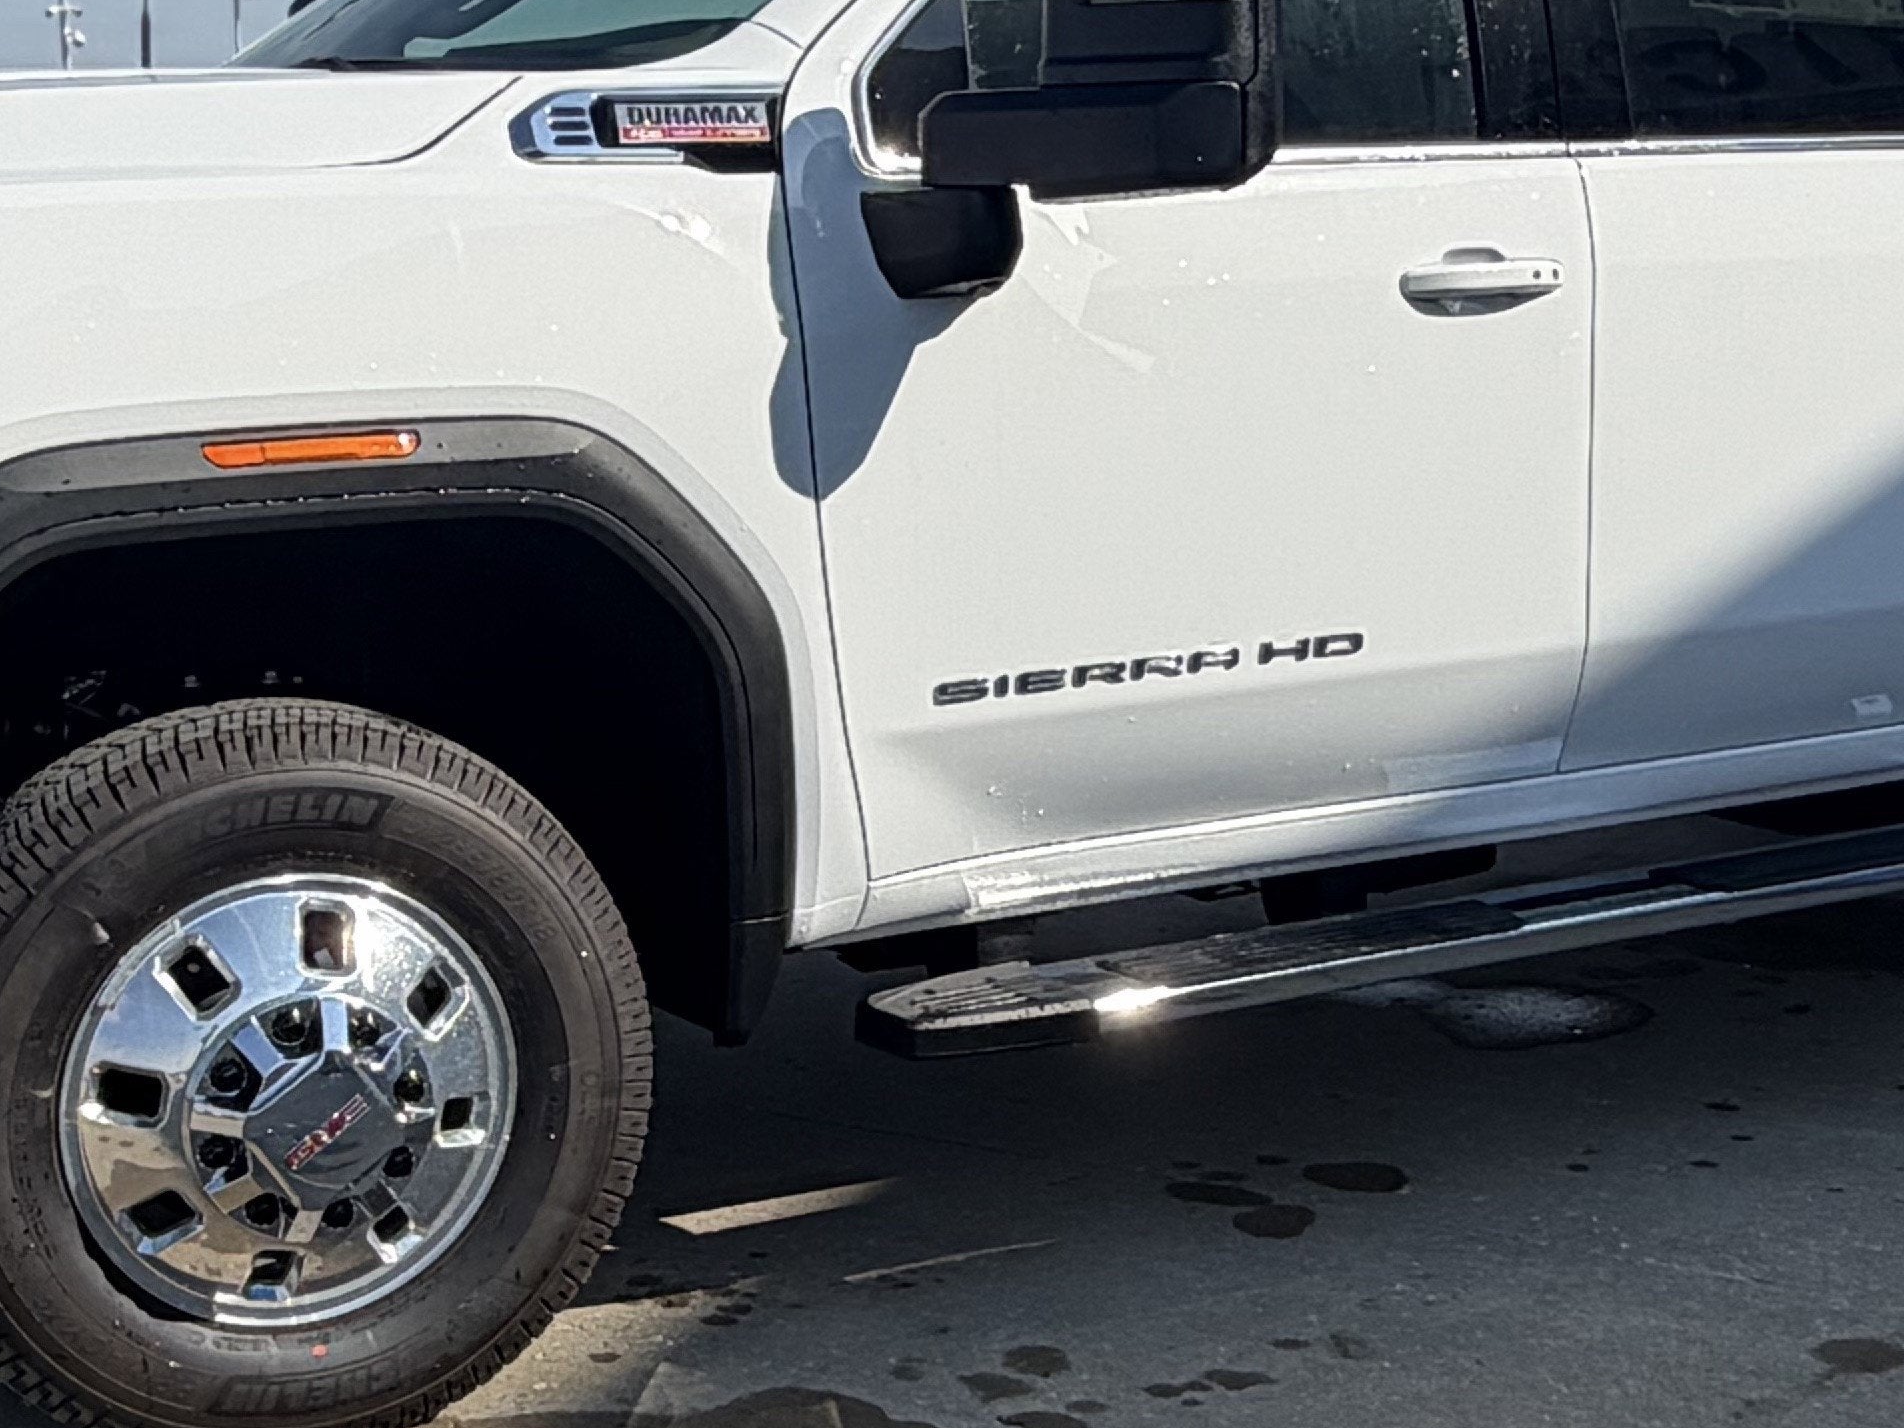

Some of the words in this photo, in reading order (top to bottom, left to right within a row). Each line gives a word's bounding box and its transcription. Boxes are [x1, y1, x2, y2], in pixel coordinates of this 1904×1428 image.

[626, 105, 759, 127] DURAMAX
[931, 647, 1241, 707] SIERRA
[1257, 631, 1365, 667] HD
[282, 1092, 371, 1171] GMC
